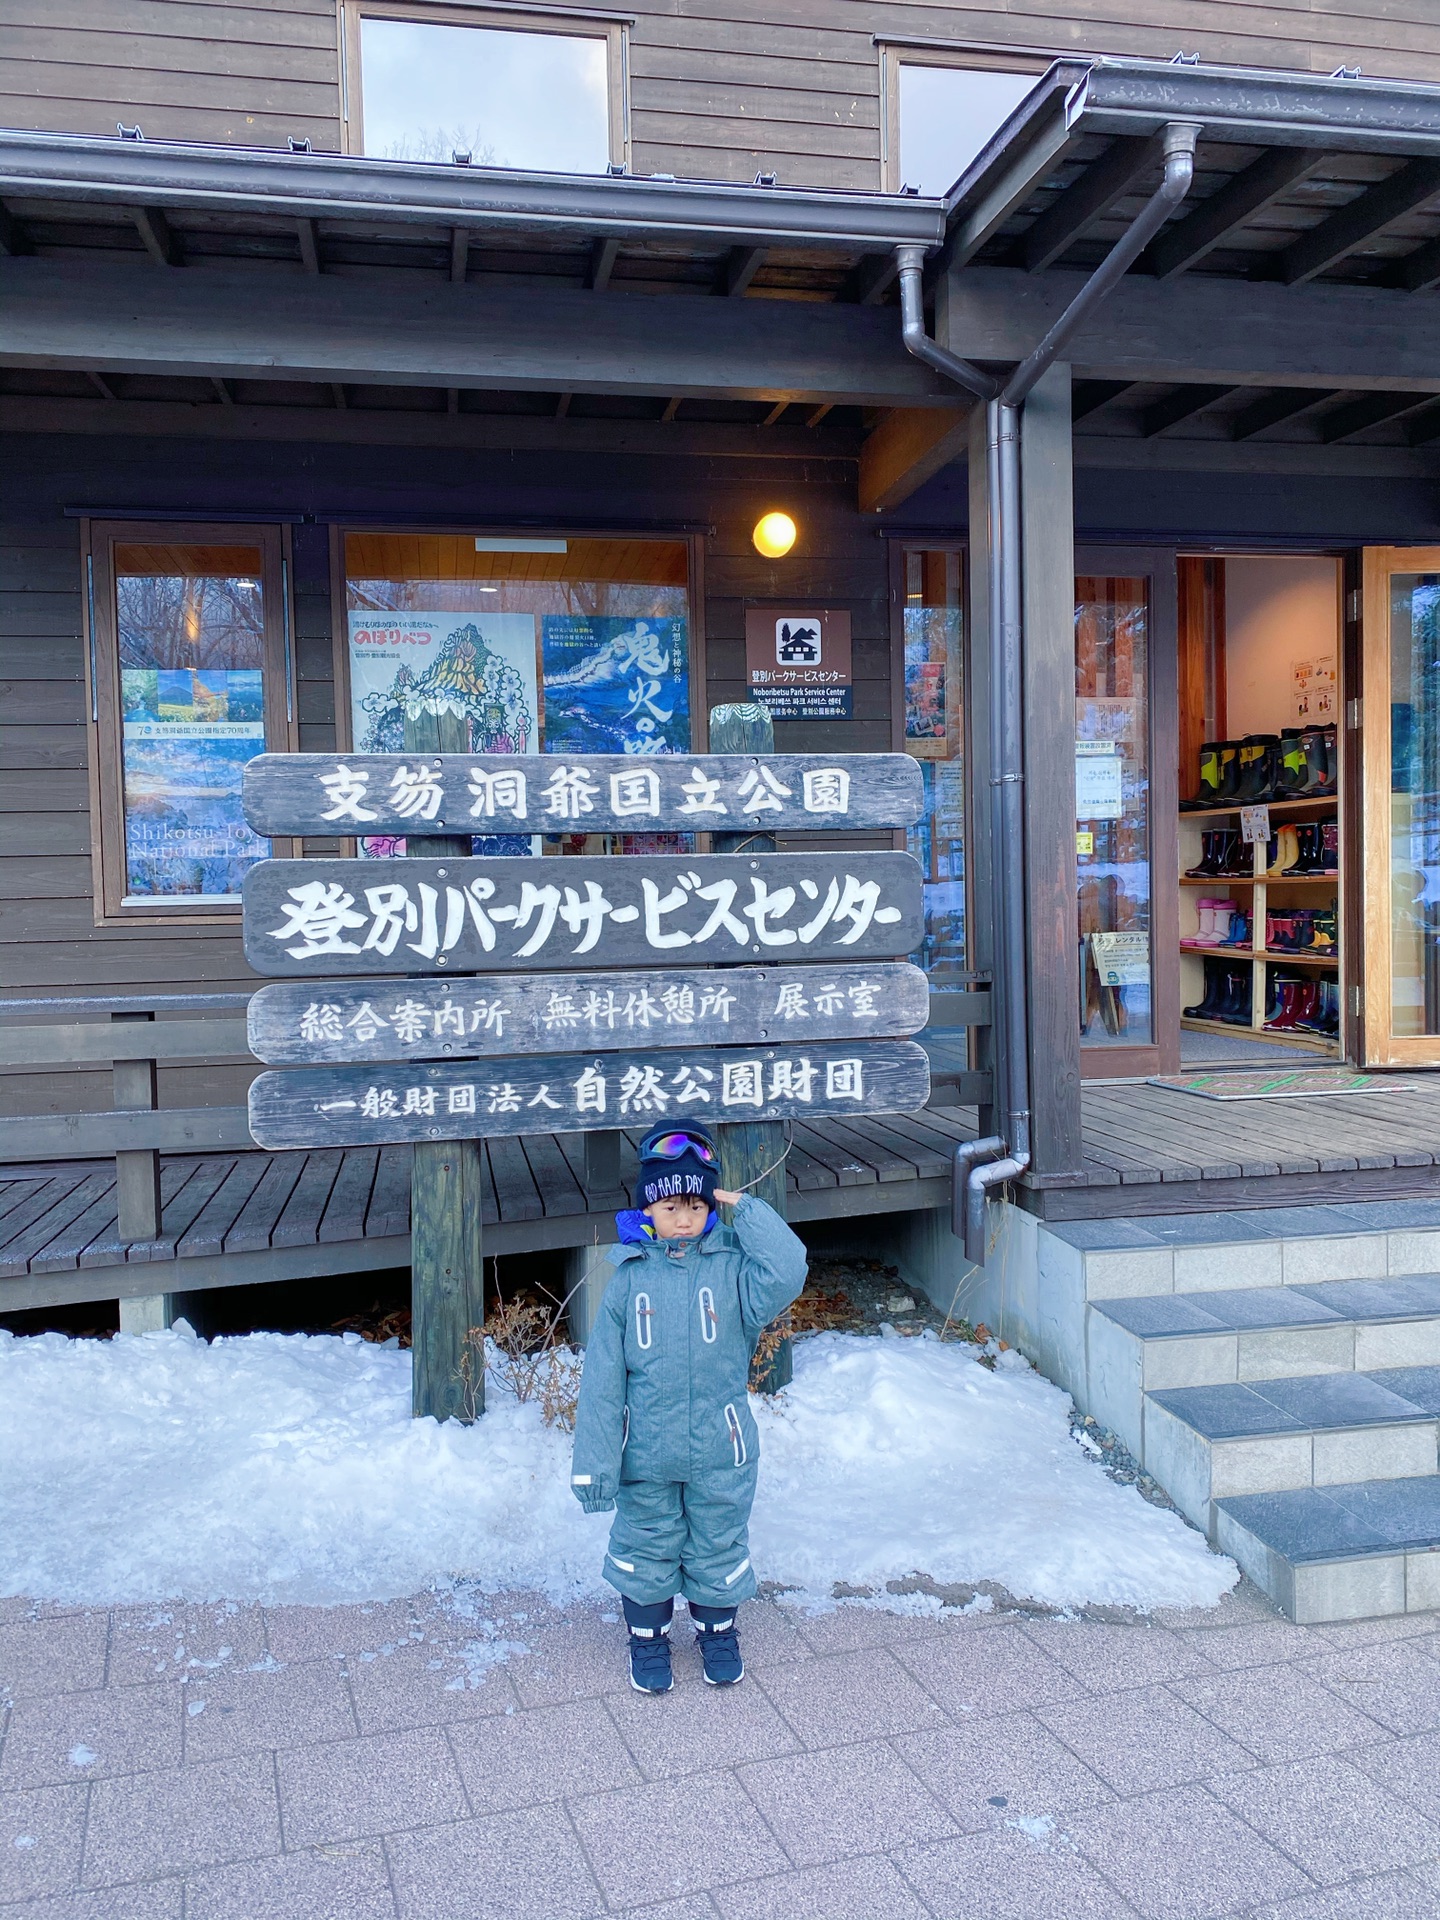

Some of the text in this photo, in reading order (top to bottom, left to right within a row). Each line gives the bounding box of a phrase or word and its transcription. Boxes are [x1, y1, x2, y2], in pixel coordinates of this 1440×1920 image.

[354, 629, 432, 645] のぼりべつ
[672, 623, 682, 683] 幻想と神秘の谷
[752, 670, 846, 683] 登別パークサービスセンター
[753, 688, 846, 696] Noboribetsu Park Service Center
[319, 765, 851, 821] 支笏洞爺国立公園
[131, 821, 260, 843] Shikotsu-Toy
[131, 840, 267, 858] National Park
[265, 871, 902, 959] 登別パークサービスセンター
[300, 980, 882, 1042] 総合案内所 無料休憩所 展示室
[658, 1174, 682, 1199] HAIR
[685, 1174, 704, 1195] DAY
